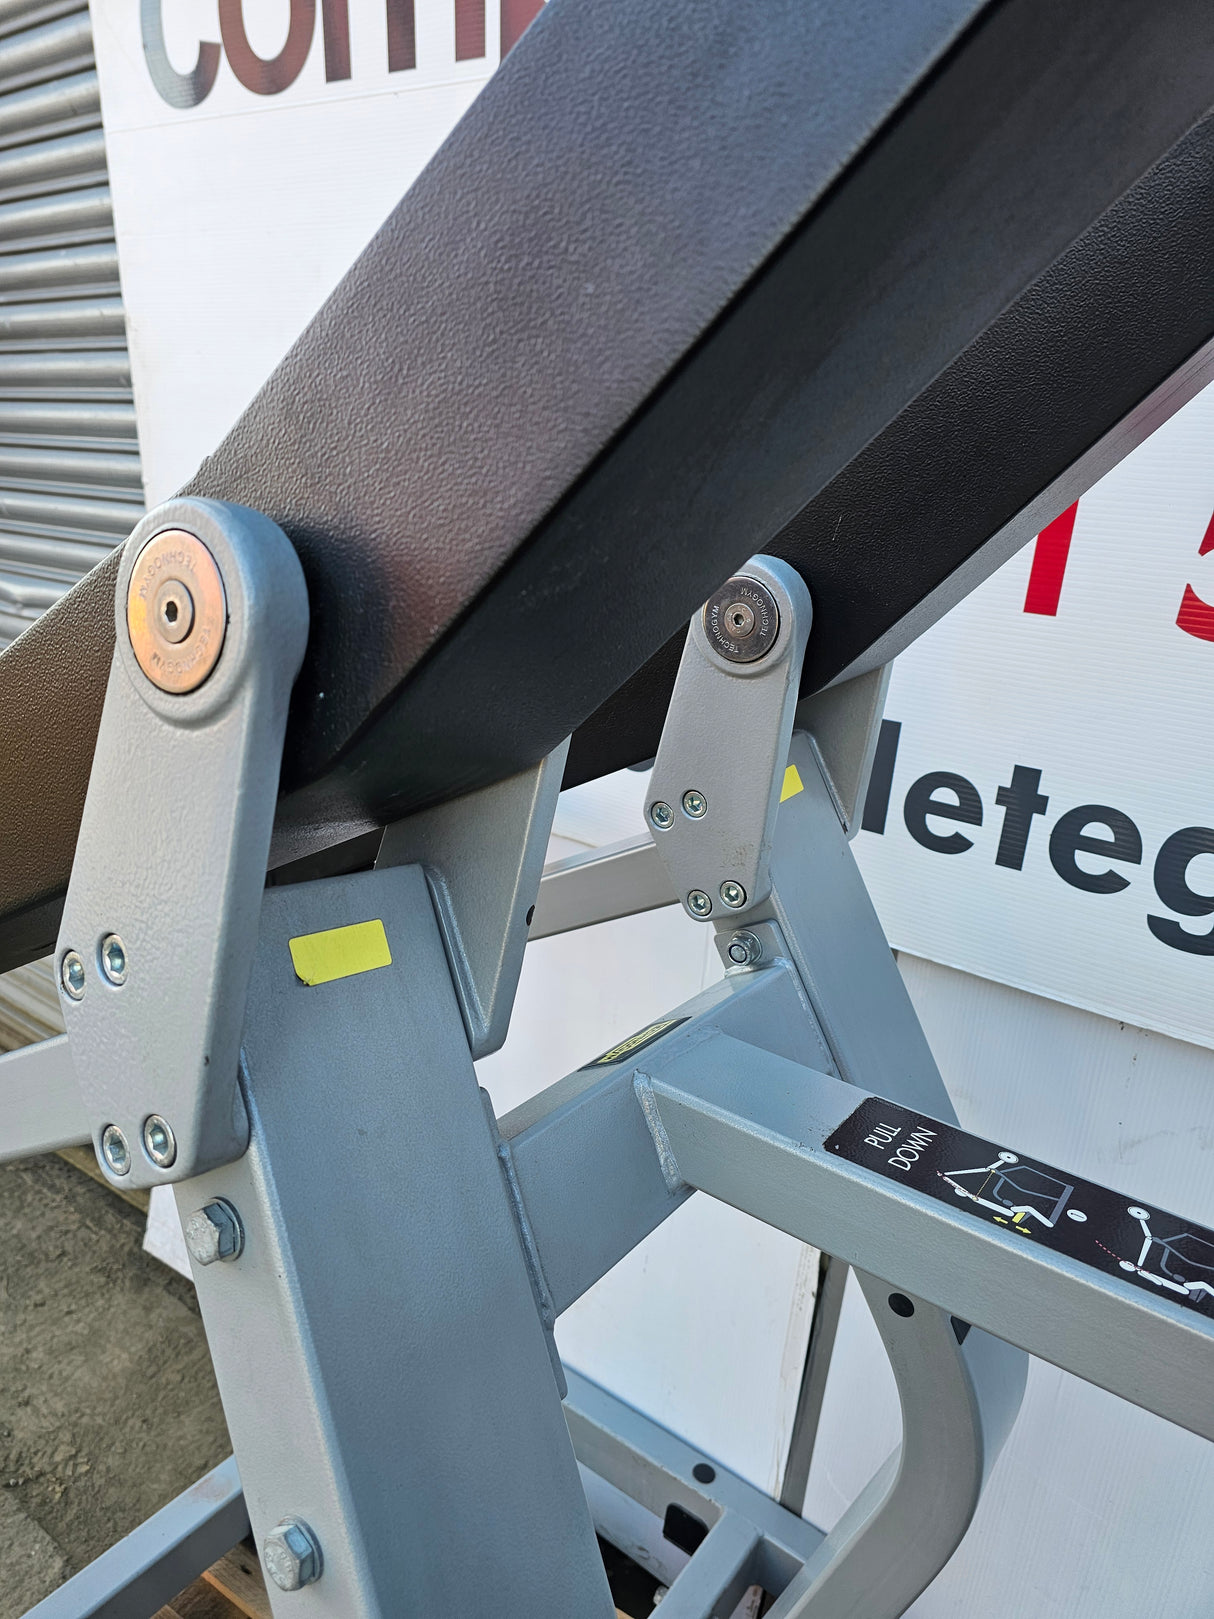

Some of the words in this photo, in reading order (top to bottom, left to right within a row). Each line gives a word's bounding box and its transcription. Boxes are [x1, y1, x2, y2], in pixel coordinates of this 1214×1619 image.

[711, 605, 739, 653] TECHNOGYM
[741, 587, 769, 637] TECHNOGYM
[864, 1122, 902, 1150] PULL
[888, 1126, 938, 1171] DOWN
